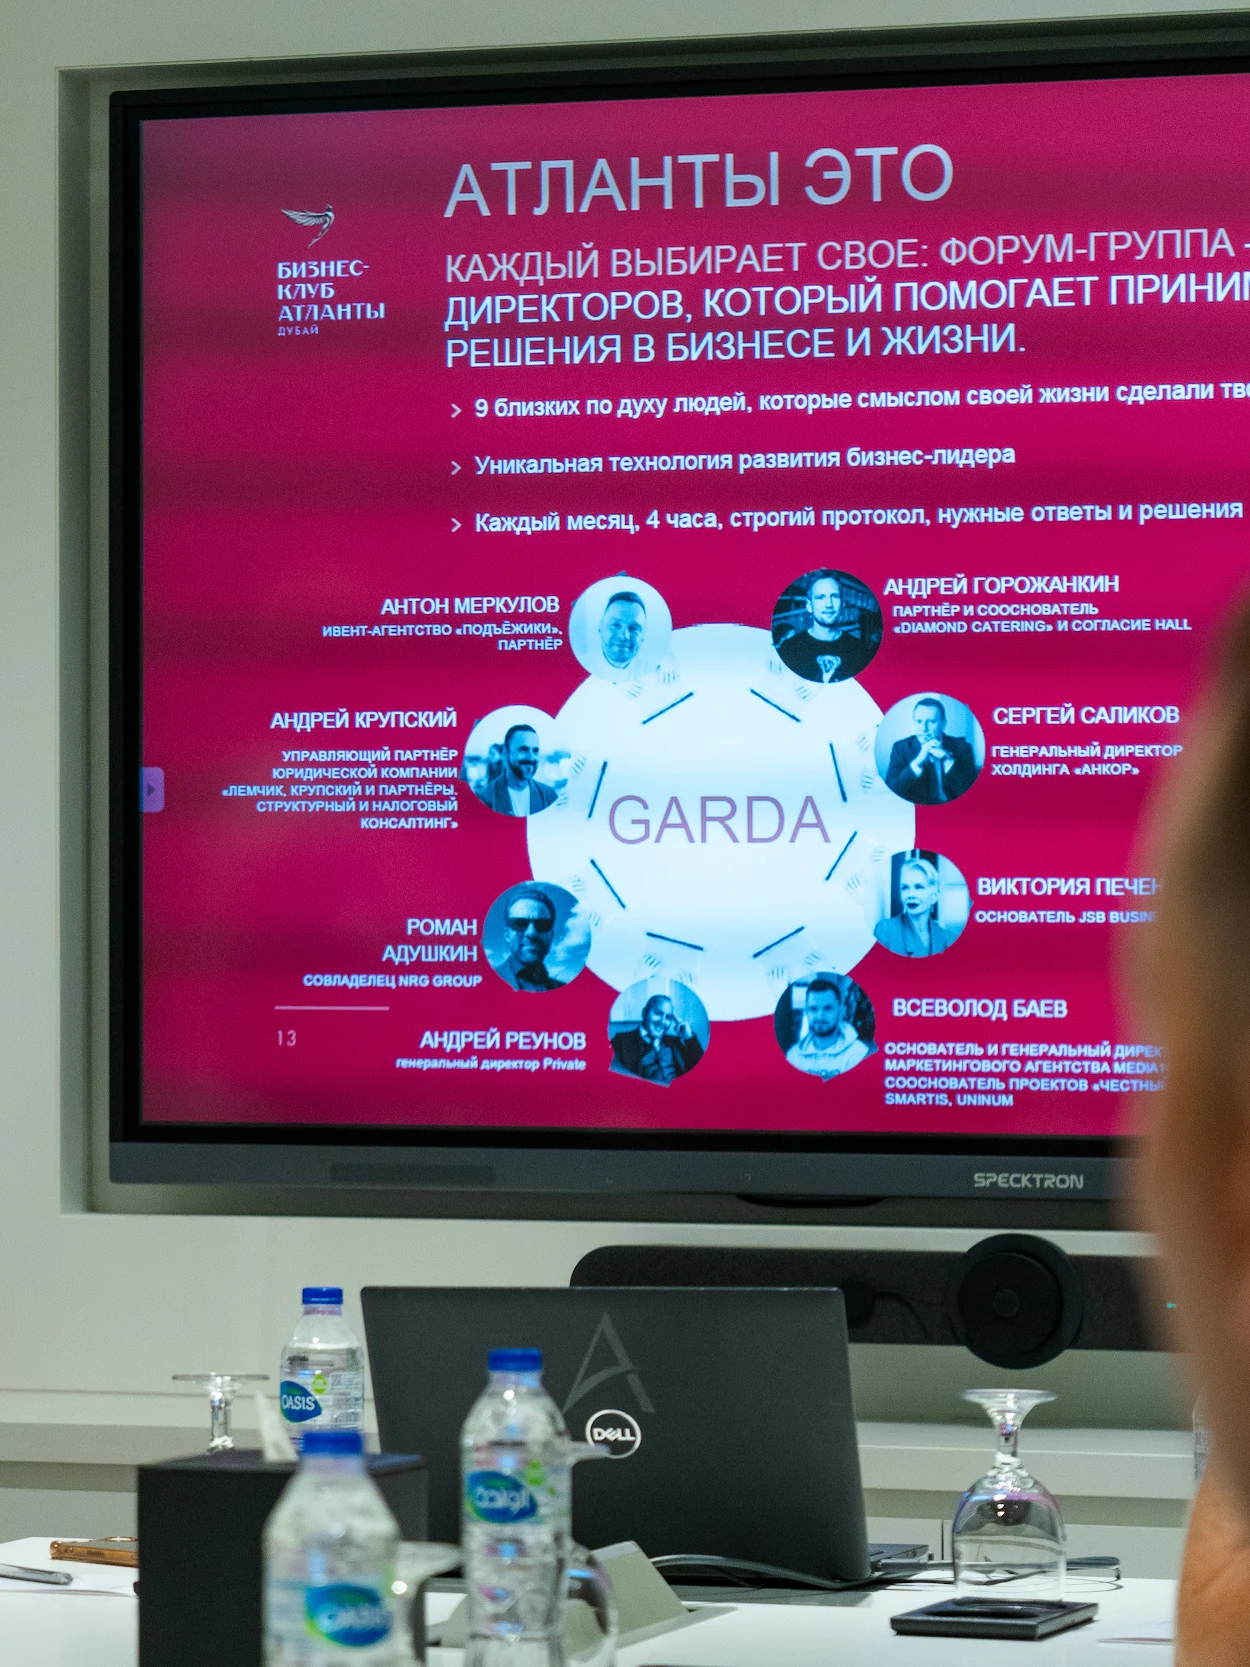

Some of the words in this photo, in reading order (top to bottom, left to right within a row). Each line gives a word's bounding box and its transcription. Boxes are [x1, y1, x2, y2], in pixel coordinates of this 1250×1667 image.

[443, 151, 780, 218] АТЛАНТЫ
[804, 143, 954, 206] ЭТО
[446, 241, 599, 288] КАЖДЫЙ
[610, 242, 808, 278] ВЫБИРАЕТ
[816, 238, 928, 271] СВОЕ:
[939, 227, 1236, 267] ФОРУМ-ГРУППА
[277, 259, 370, 279] БИЗНЕС-
[277, 282, 335, 300] КЛУБ
[443, 289, 695, 332] ДИРЕКТОРОВ,
[704, 275, 882, 318] КОТОРЫЙ
[894, 275, 1100, 312] ПОМОГАЕТ
[1110, 270, 1250, 306] ПРИНИ
[278, 302, 385, 322] АТЛАНТЫ
[277, 323, 319, 337] ДУБАЙ
[446, 334, 622, 368] РЕШЕНИЯ
[633, 333, 656, 363] В
[667, 327, 836, 362] БИЗНЕСЕ
[847, 326, 871, 357] И
[880, 322, 1026, 356] ЖИЗНИ.
[474, 398, 489, 418] 9
[493, 397, 581, 418] близких
[586, 398, 614, 415] по
[616, 397, 669, 420] духу
[672, 391, 753, 416] людей,
[759, 392, 853, 415] которые
[856, 389, 961, 409] смыслом
[965, 383, 1034, 406] своей
[1038, 385, 1110, 404] жизни
[1115, 382, 1215, 406] сделали
[1219, 382, 1250, 399] тв
[474, 455, 604, 475] Уникальная
[608, 453, 733, 472] технология
[738, 451, 841, 475] развития
[846, 446, 1016, 470] бизнес-лидера
[475, 511, 561, 536] Каждый
[567, 513, 640, 535] месяц,
[645, 509, 661, 529] 4
[665, 512, 723, 531] часа,
[729, 506, 816, 532] строгий
[821, 508, 931, 531] протокол,
[937, 506, 1025, 529] нужные
[1030, 504, 1113, 522] ответы
[1118, 504, 1133, 521] и
[1139, 501, 1244, 526] решения
[883, 573, 967, 599] АНДРЕЙ
[973, 574, 1120, 595] ГОРОЖАНКИН
[380, 597, 450, 616] АНТОН
[453, 595, 561, 615] МЕРКУЛОВ
[962, 604, 975, 617] И
[976, 602, 1100, 617] СООСНОВАТЕЛЬ
[322, 623, 453, 638] ИВЕНТ-АГЕНТСТВО
[893, 620, 968, 634] «DIAMOND
[970, 619, 1054, 633] CATERING»
[1056, 619, 1069, 632] И
[1070, 618, 1152, 632] СОГЛАСИЕ
[1154, 618, 1193, 631] HALL
[269, 708, 350, 732] АНДРЕЙ
[354, 706, 458, 729] КРУПСКИЙ
[992, 702, 1076, 725] СЕРГЕЙ
[1079, 705, 1181, 725] САЛИКОВ
[281, 745, 391, 764] УПРАВЛЯЮЩИЙ
[991, 740, 1102, 758] ГЕНЕРАЛЬНЫЙ
[1102, 744, 1183, 761] ДИРЕКТОР
[272, 763, 378, 782] ЮРИДИЧЕСКОЙ
[380, 766, 458, 779] КОМПАНИИ
[991, 763, 1071, 779] ХОЛДИНГА
[1073, 762, 1140, 776] «АНКОР»
[290, 780, 361, 797] КРУПСКИЙ
[365, 784, 376, 796] И
[255, 796, 356, 813] СТРУКТУРНЫЙ
[358, 800, 370, 812] И
[371, 796, 459, 812] НАЛОГОВЫЙ
[360, 816, 459, 830] КОНСАЛТИНГ»
[608, 794, 832, 845] GARDA
[977, 877, 1091, 896] ВИКТОРИЯ
[974, 909, 1076, 924] ОСНОВАТЕЛЬ
[1078, 910, 1107, 924] JSB
[406, 918, 478, 936] РОМАН
[381, 944, 478, 966] АДУШКИН
[302, 973, 397, 990] СОВЛАДЕЛЕЦ
[397, 974, 431, 988] NRG
[431, 974, 483, 988] GROUP
[892, 997, 1009, 1022] ВСЕВОЛОД
[1012, 998, 1069, 1019] БАЕВ
[277, 1029, 297, 1047] 13
[419, 1027, 501, 1053] АНДРЕЙ
[505, 1030, 587, 1051] РЕУНОВ
[884, 1041, 985, 1057] ОСНОВАТЕЛЬ
[986, 1043, 999, 1057] И
[1001, 1040, 1112, 1058] ГЕНЕРАЛЬНЫЙ
[395, 1055, 479, 1072] генеральный
[480, 1058, 541, 1073] директор
[542, 1056, 587, 1071] Private
[884, 1058, 1022, 1074] МАРКЕТИНГОВОГО
[1023, 1059, 1112, 1075] АГЕНТСТВА
[884, 1075, 1006, 1091] СООСНОВАТЕЛЬ
[1008, 1077, 1089, 1092] ПРОЕКТОВ
[956, 1093, 1014, 1107] UNINUM
[973, 1172, 1085, 1190] SPECKTRON
[281, 1394, 317, 1412] OASIS
[592, 1427, 636, 1442] DELL
